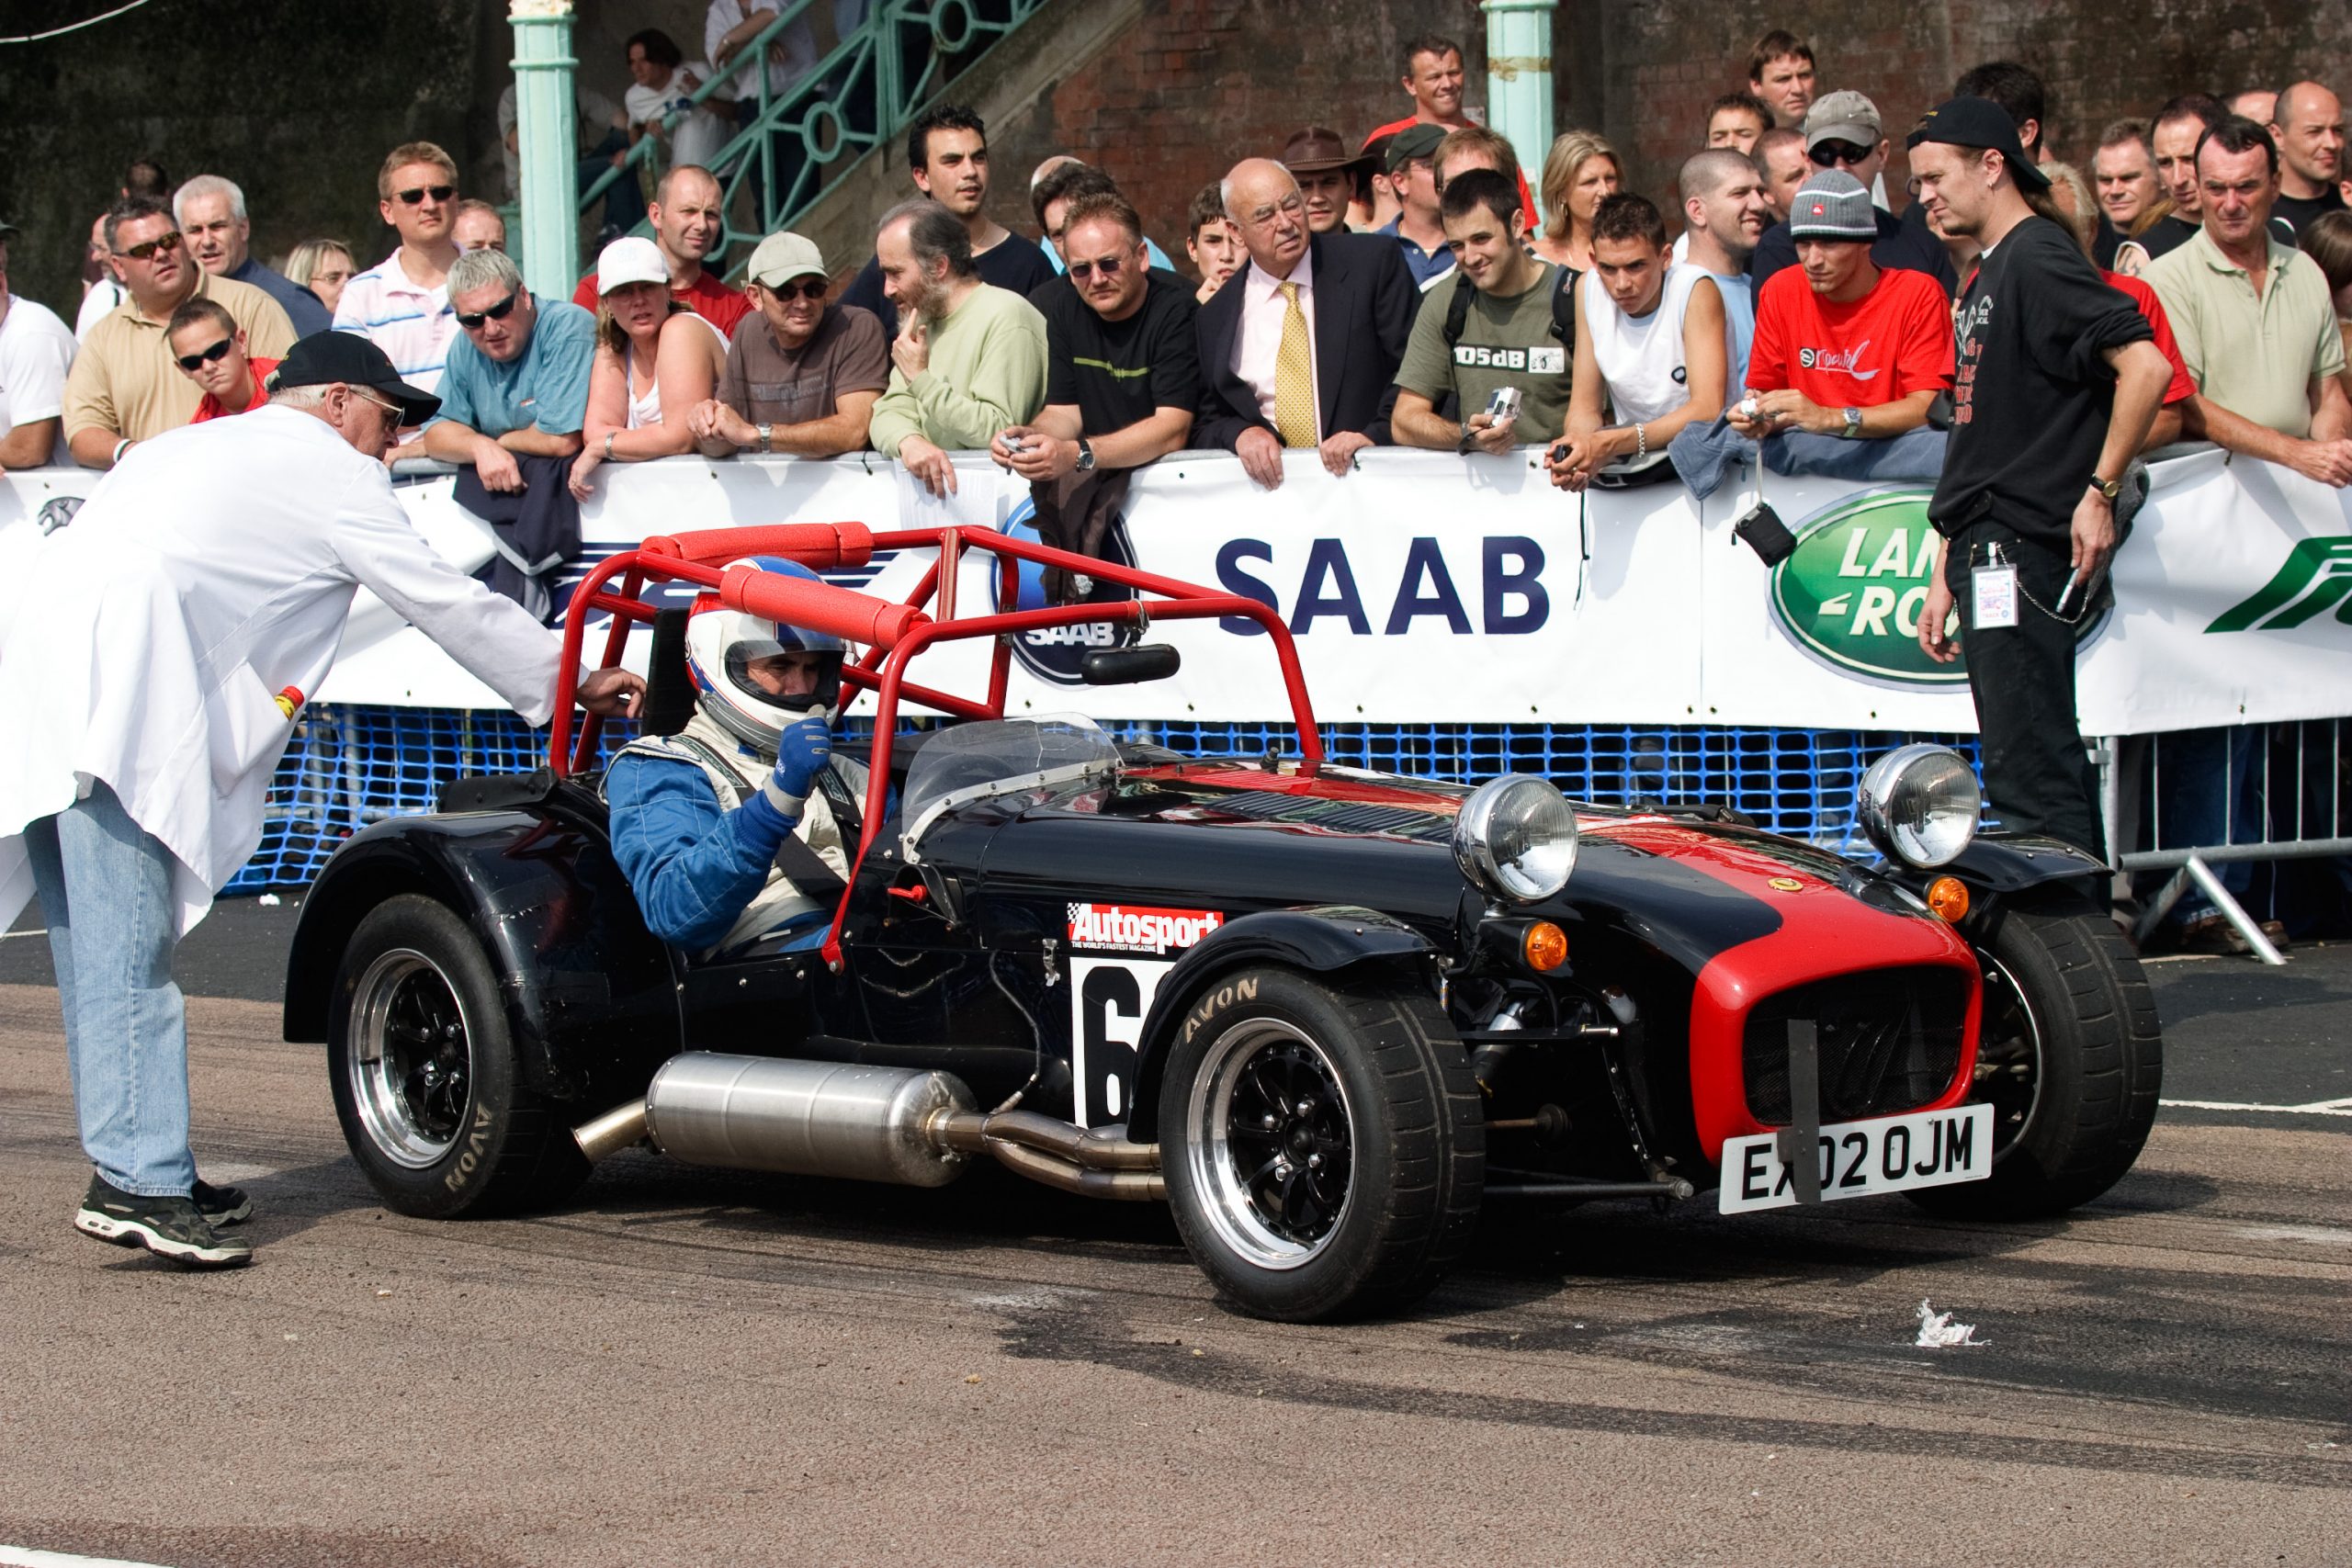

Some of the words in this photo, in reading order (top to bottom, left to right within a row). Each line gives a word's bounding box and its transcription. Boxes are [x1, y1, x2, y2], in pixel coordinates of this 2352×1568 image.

[1453, 346, 1525, 368] 105dB
[1216, 536, 1550, 636] SAAB
[1024, 622, 1115, 647] SAAB
[1072, 903, 1219, 954] Autosport
[1082, 942, 1105, 950] WORLD'S
[1106, 942, 1128, 951] FASTEST
[1129, 944, 1157, 953] MAGAZINE
[1185, 976, 1259, 1044] AVON
[445, 1102, 492, 1191] AVON
